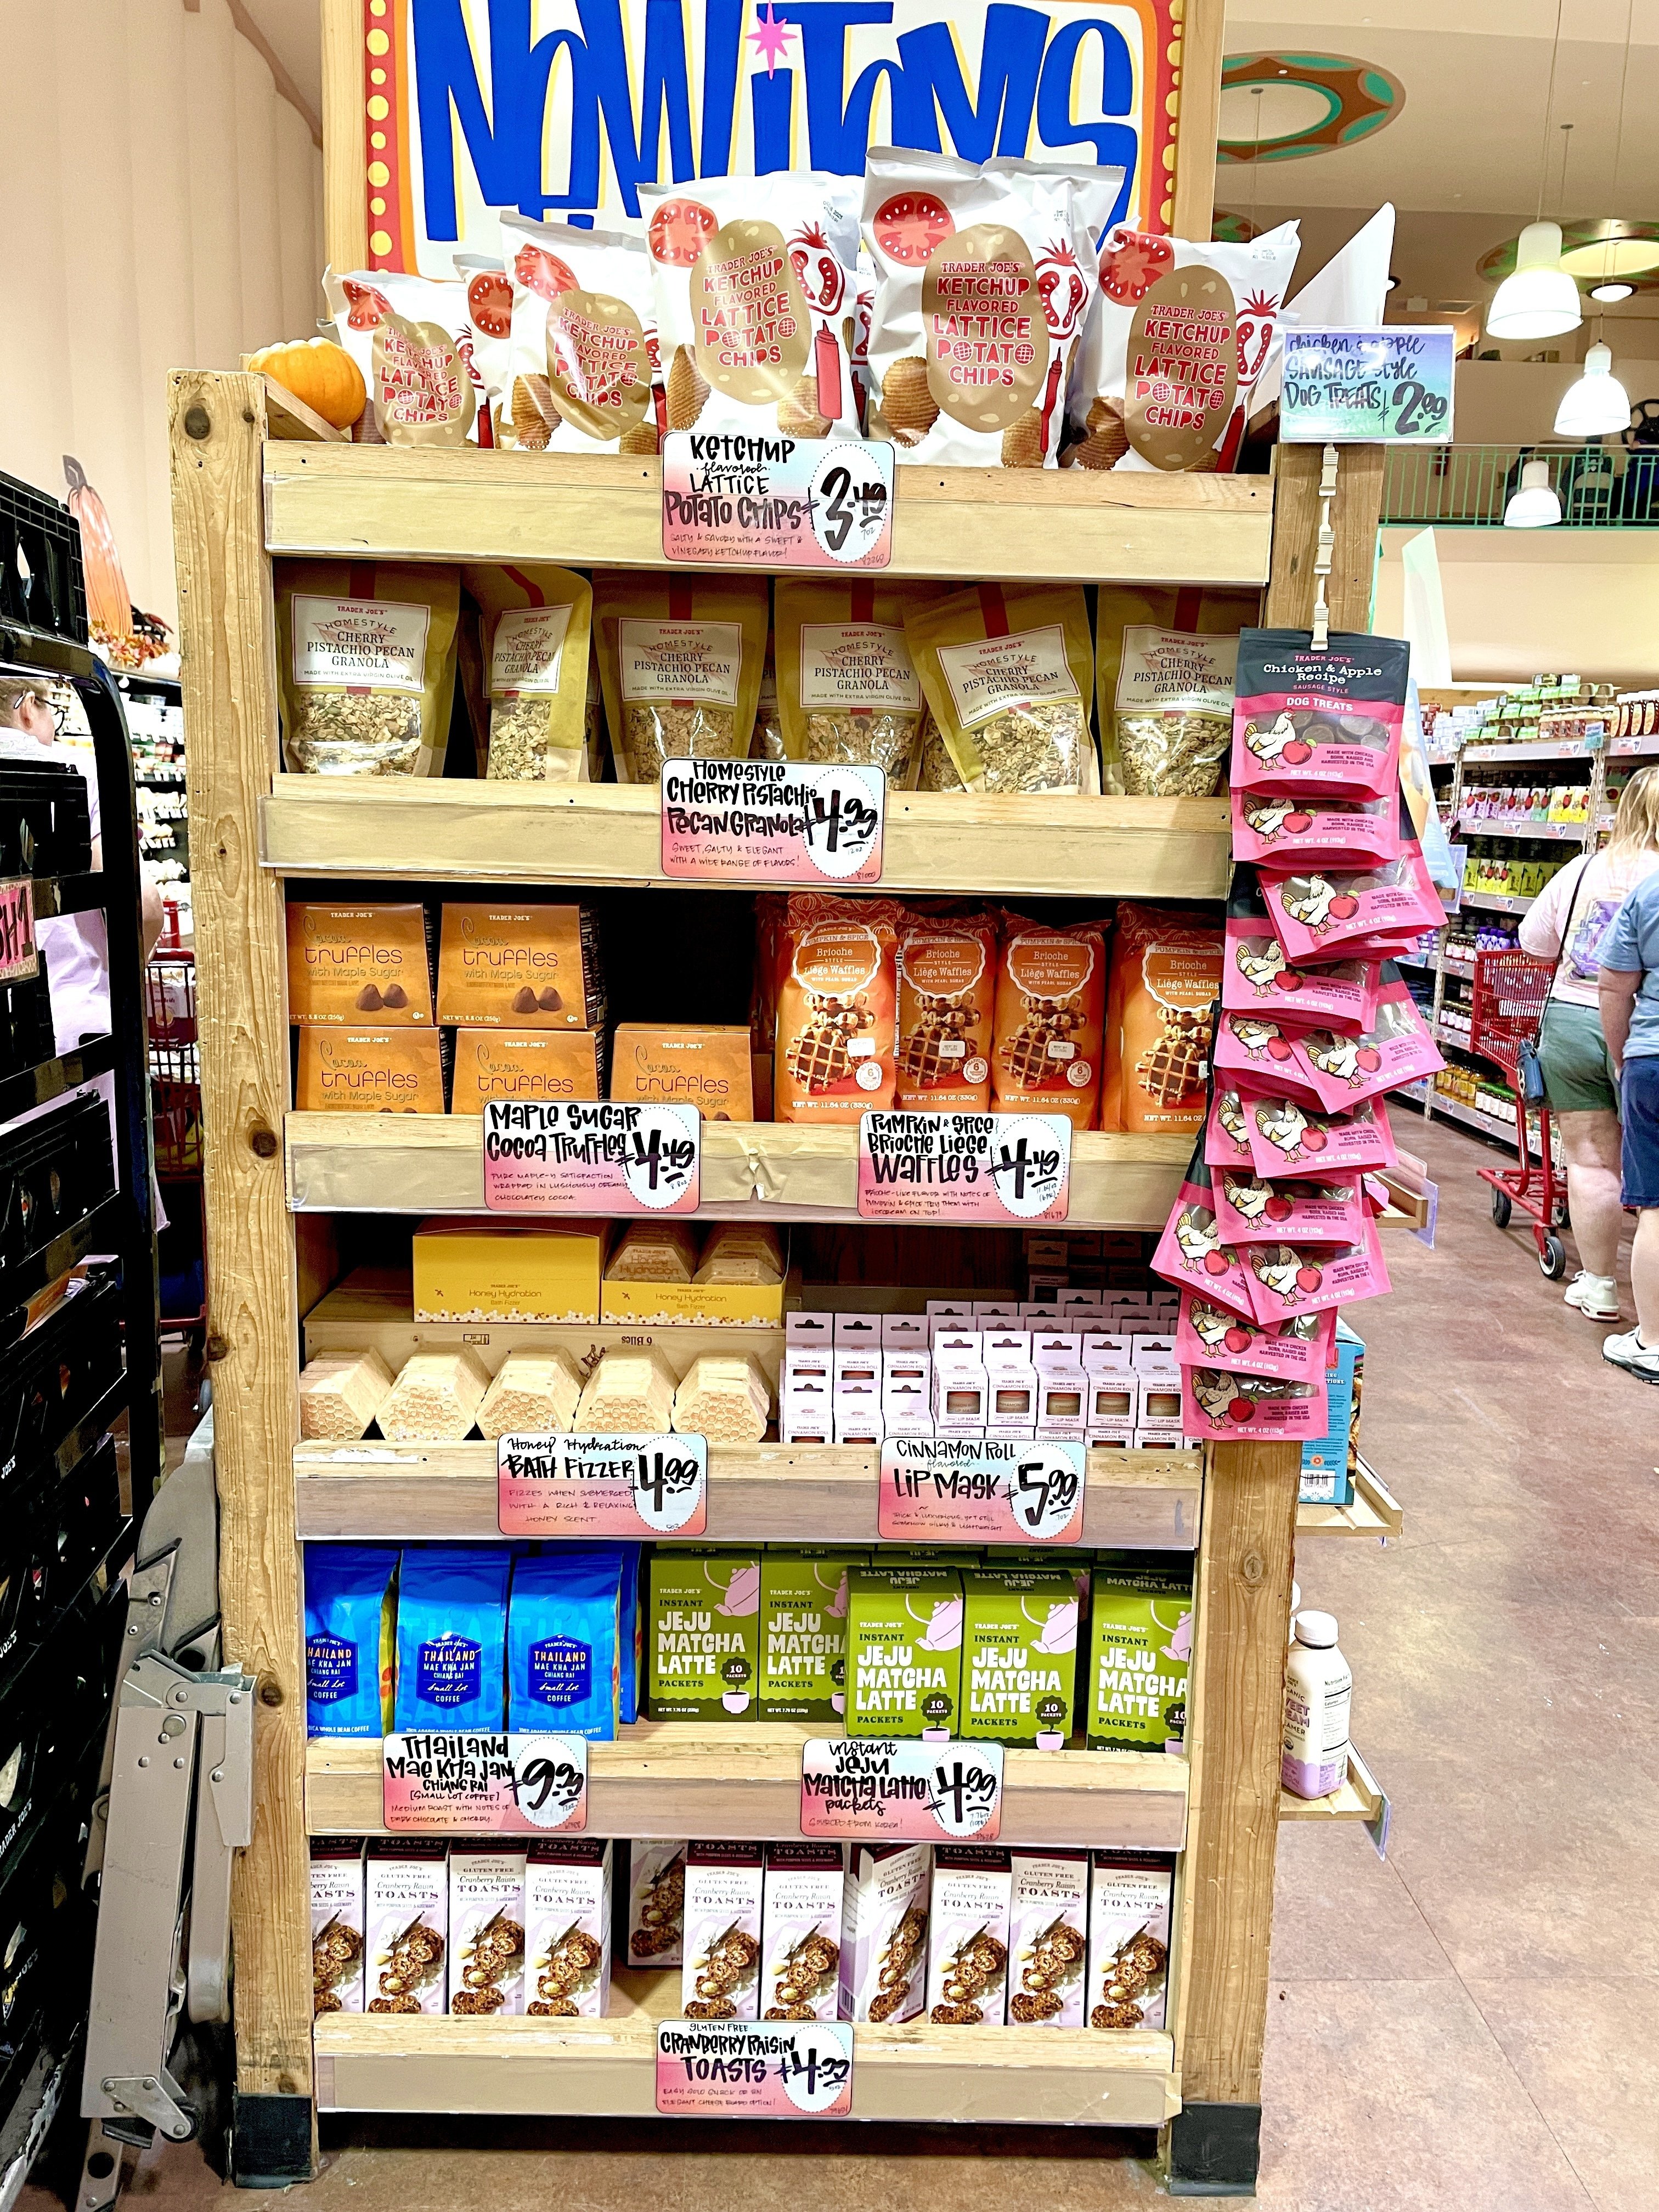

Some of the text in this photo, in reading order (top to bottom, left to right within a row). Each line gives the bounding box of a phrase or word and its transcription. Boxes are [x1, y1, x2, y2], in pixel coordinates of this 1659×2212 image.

[936, 277, 1031, 297] KETCHUP
[946, 300, 1019, 314] FLAVORED
[933, 313, 1032, 340] LATTICE
[935, 340, 1036, 366] POTATO
[947, 365, 1015, 387] CHIPS
[1134, 356, 1228, 386] LATTICE
[1134, 380, 1224, 411] POTATO
[1324, 381, 1381, 409] TREATS
[1144, 405, 1206, 431] CHIPS
[324, 618, 397, 635] HOMESTYLE
[337, 631, 386, 644] CHERRY
[307, 642, 415, 658] PISTACHIO PECAN
[331, 656, 389, 668] GRANOLA
[1328, 656, 1352, 664] JOE'S
[1263, 664, 1322, 674] Chicken
[1339, 666, 1382, 678] Apple
[1296, 673, 1346, 685] Recipe
[1286, 697, 1353, 712] DOG TREATS
[746, 846, 784, 854] ELEGANT
[721, 858, 748, 867] RANGE
[463, 947, 558, 967] truffles
[926, 950, 960, 958] Brioche
[464, 970, 558, 981] with Maple Sugar
[913, 967, 972, 978] Liège Waffles
[656, 1293, 682, 1302] Honey
[507, 1437, 556, 1453] Honey
[501, 1454, 557, 1478] BATH
[534, 1650, 586, 1662] THAILAND
[857, 1646, 913, 1667] JEJU
[571, 1662, 585, 1671] JAN
[857, 1668, 947, 1689] MATCHA
[856, 1690, 917, 1711] LATTE
[828, 1741, 897, 1756] instant
[727, 2024, 748, 2032] FREE
[680, 2056, 767, 2083] TOASTS
